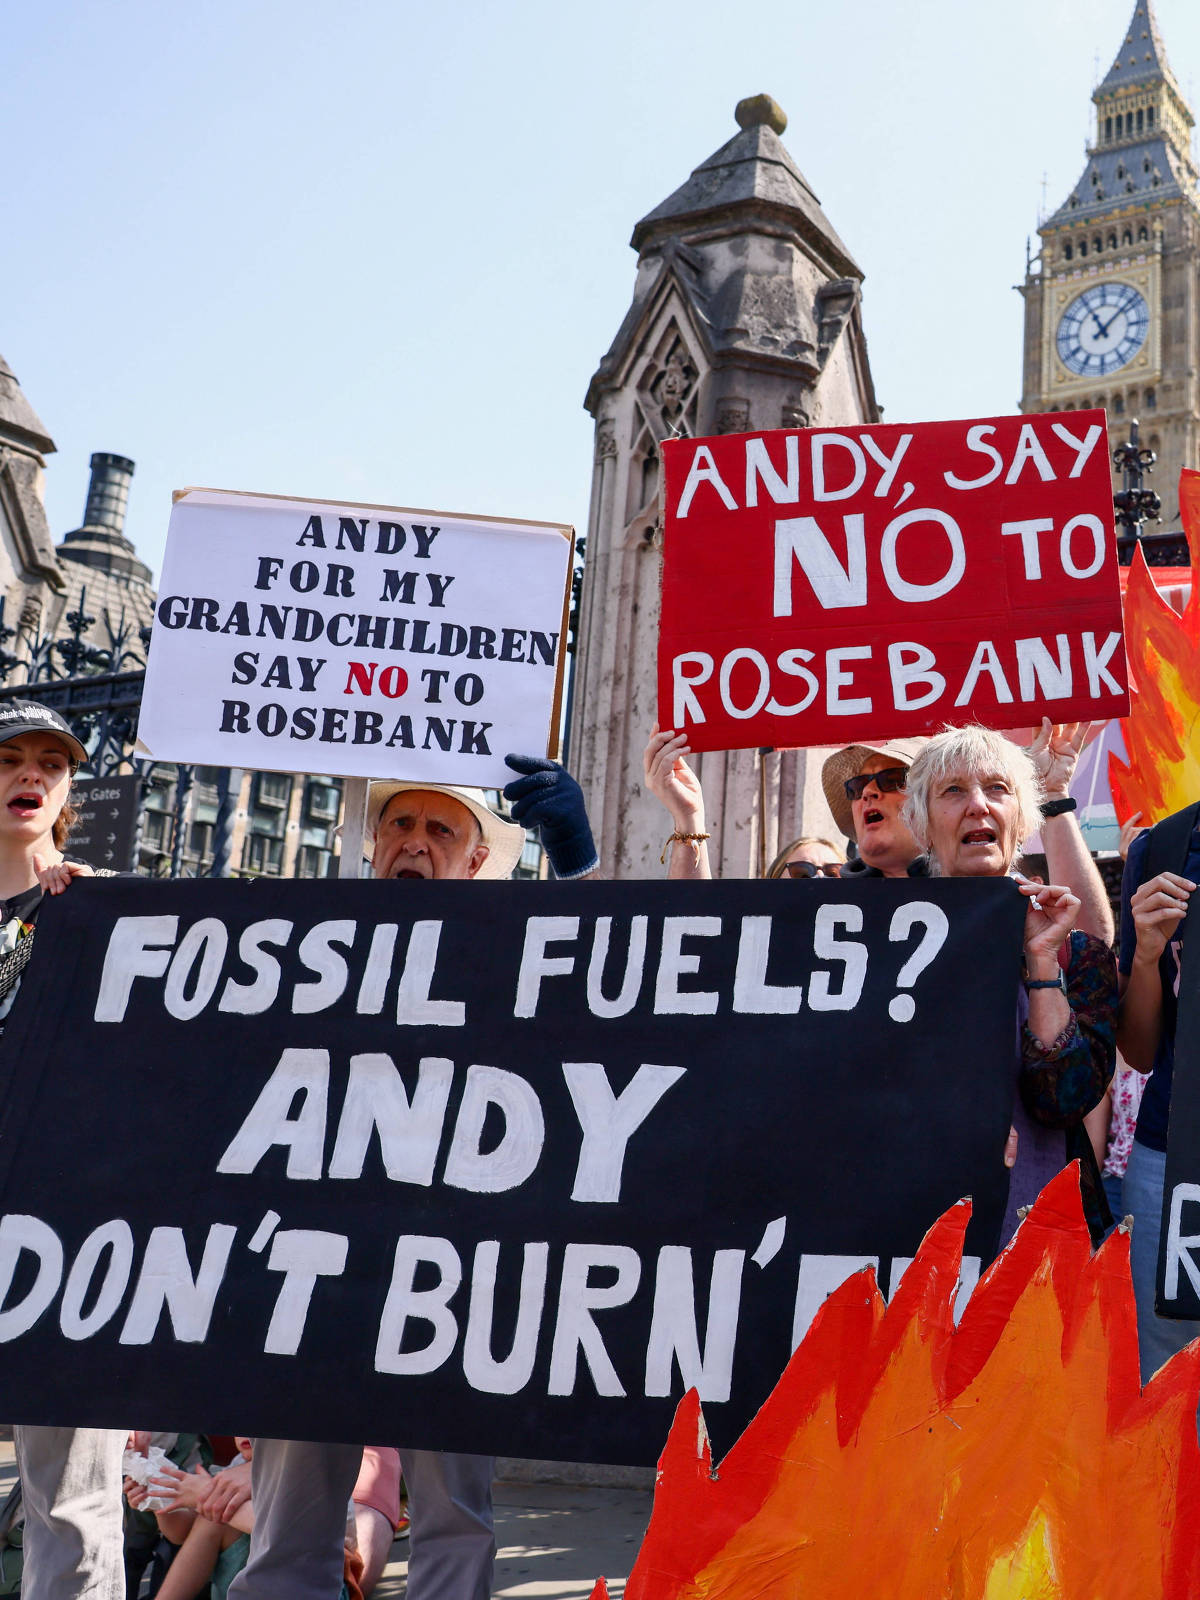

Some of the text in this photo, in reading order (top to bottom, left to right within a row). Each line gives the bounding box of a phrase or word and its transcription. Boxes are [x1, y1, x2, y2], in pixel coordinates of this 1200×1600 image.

[677, 424, 1102, 518] ANDY, SAY
[254, 557, 455, 607] FOR MY
[296, 515, 440, 558] ANDY
[773, 508, 1106, 617] NO TO
[159, 596, 559, 666] GRANDCHILDREN
[232, 652, 484, 706] SAY NO TO
[672, 631, 1125, 729] ROSEBANK
[219, 700, 493, 756] ROSEBANK
[94, 901, 949, 1026] FOSSIL FUELS?
[216, 1048, 687, 1202] ANDY
[0, 1210, 348, 1356] DON'T
